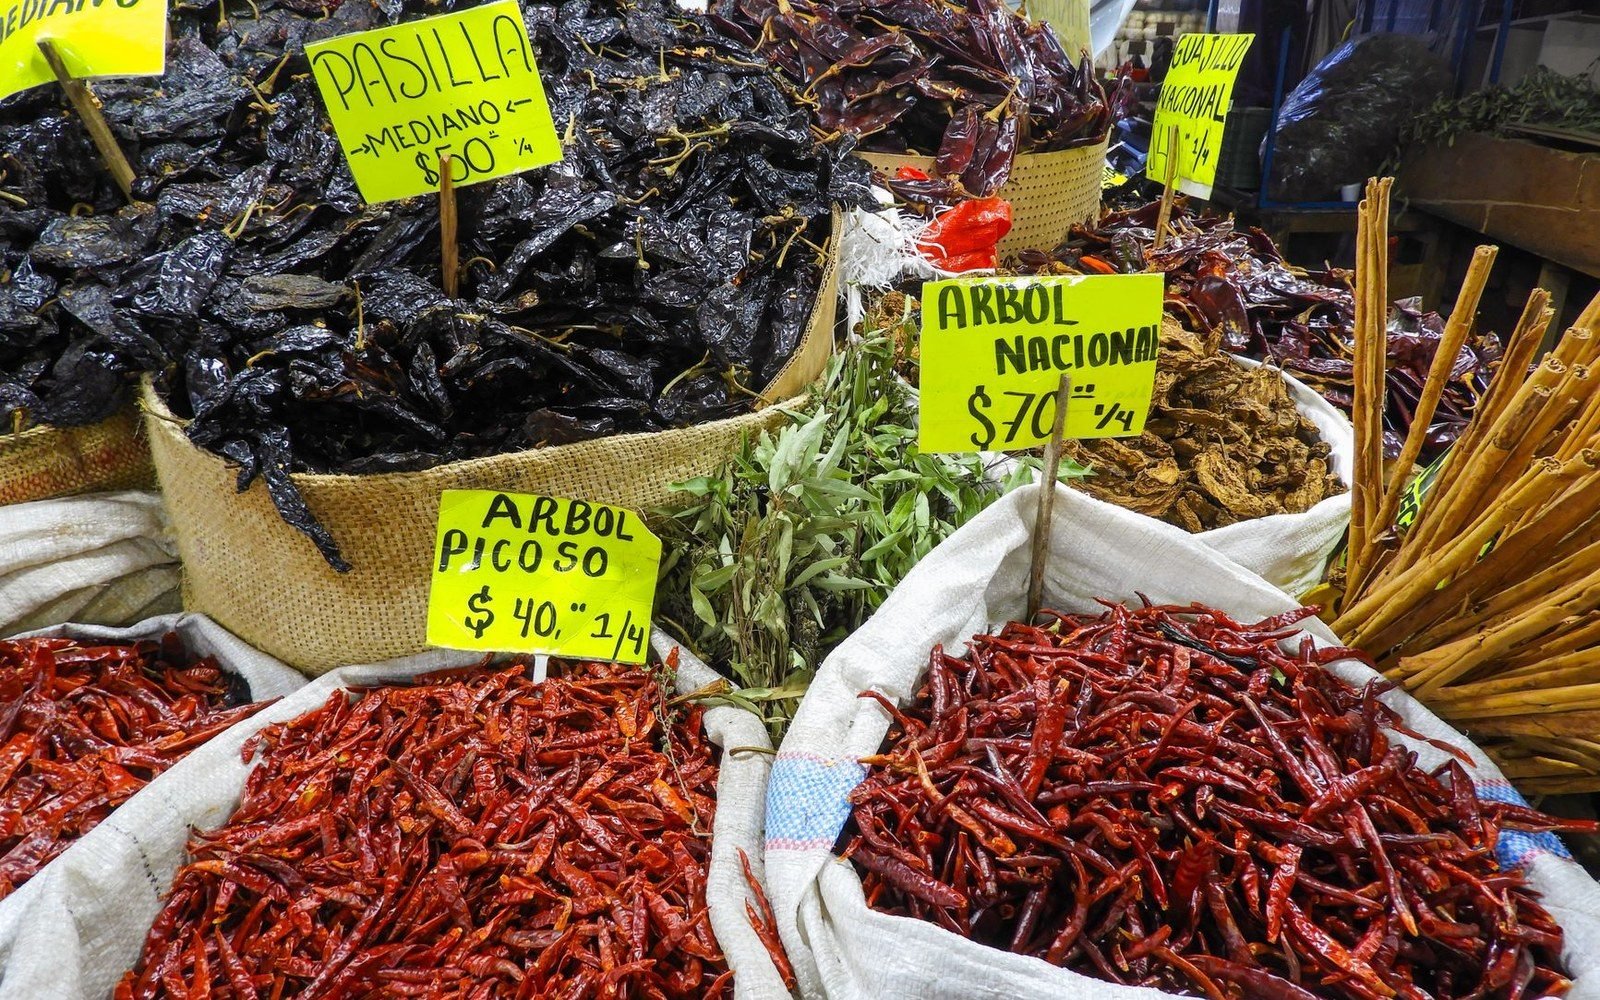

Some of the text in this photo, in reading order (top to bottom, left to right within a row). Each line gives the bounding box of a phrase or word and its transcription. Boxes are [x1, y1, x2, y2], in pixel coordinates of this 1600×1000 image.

[313, 15, 532, 110] PASILLA
[1172, 35, 1250, 73] GUAJILLO
[1160, 83, 1226, 123] NACIONAL
[366, 100, 501, 157] MEDIANO
[513, 137, 534, 156] 1/4
[1192, 128, 1210, 174] 1/4
[938, 283, 1079, 330] ARBOL
[994, 324, 1159, 376] NACIONAL
[1093, 402, 1135, 432] 1/4
[482, 493, 634, 542] ARBOL
[438, 529, 609, 578] PICOSO
[590, 610, 645, 662] 1/4
